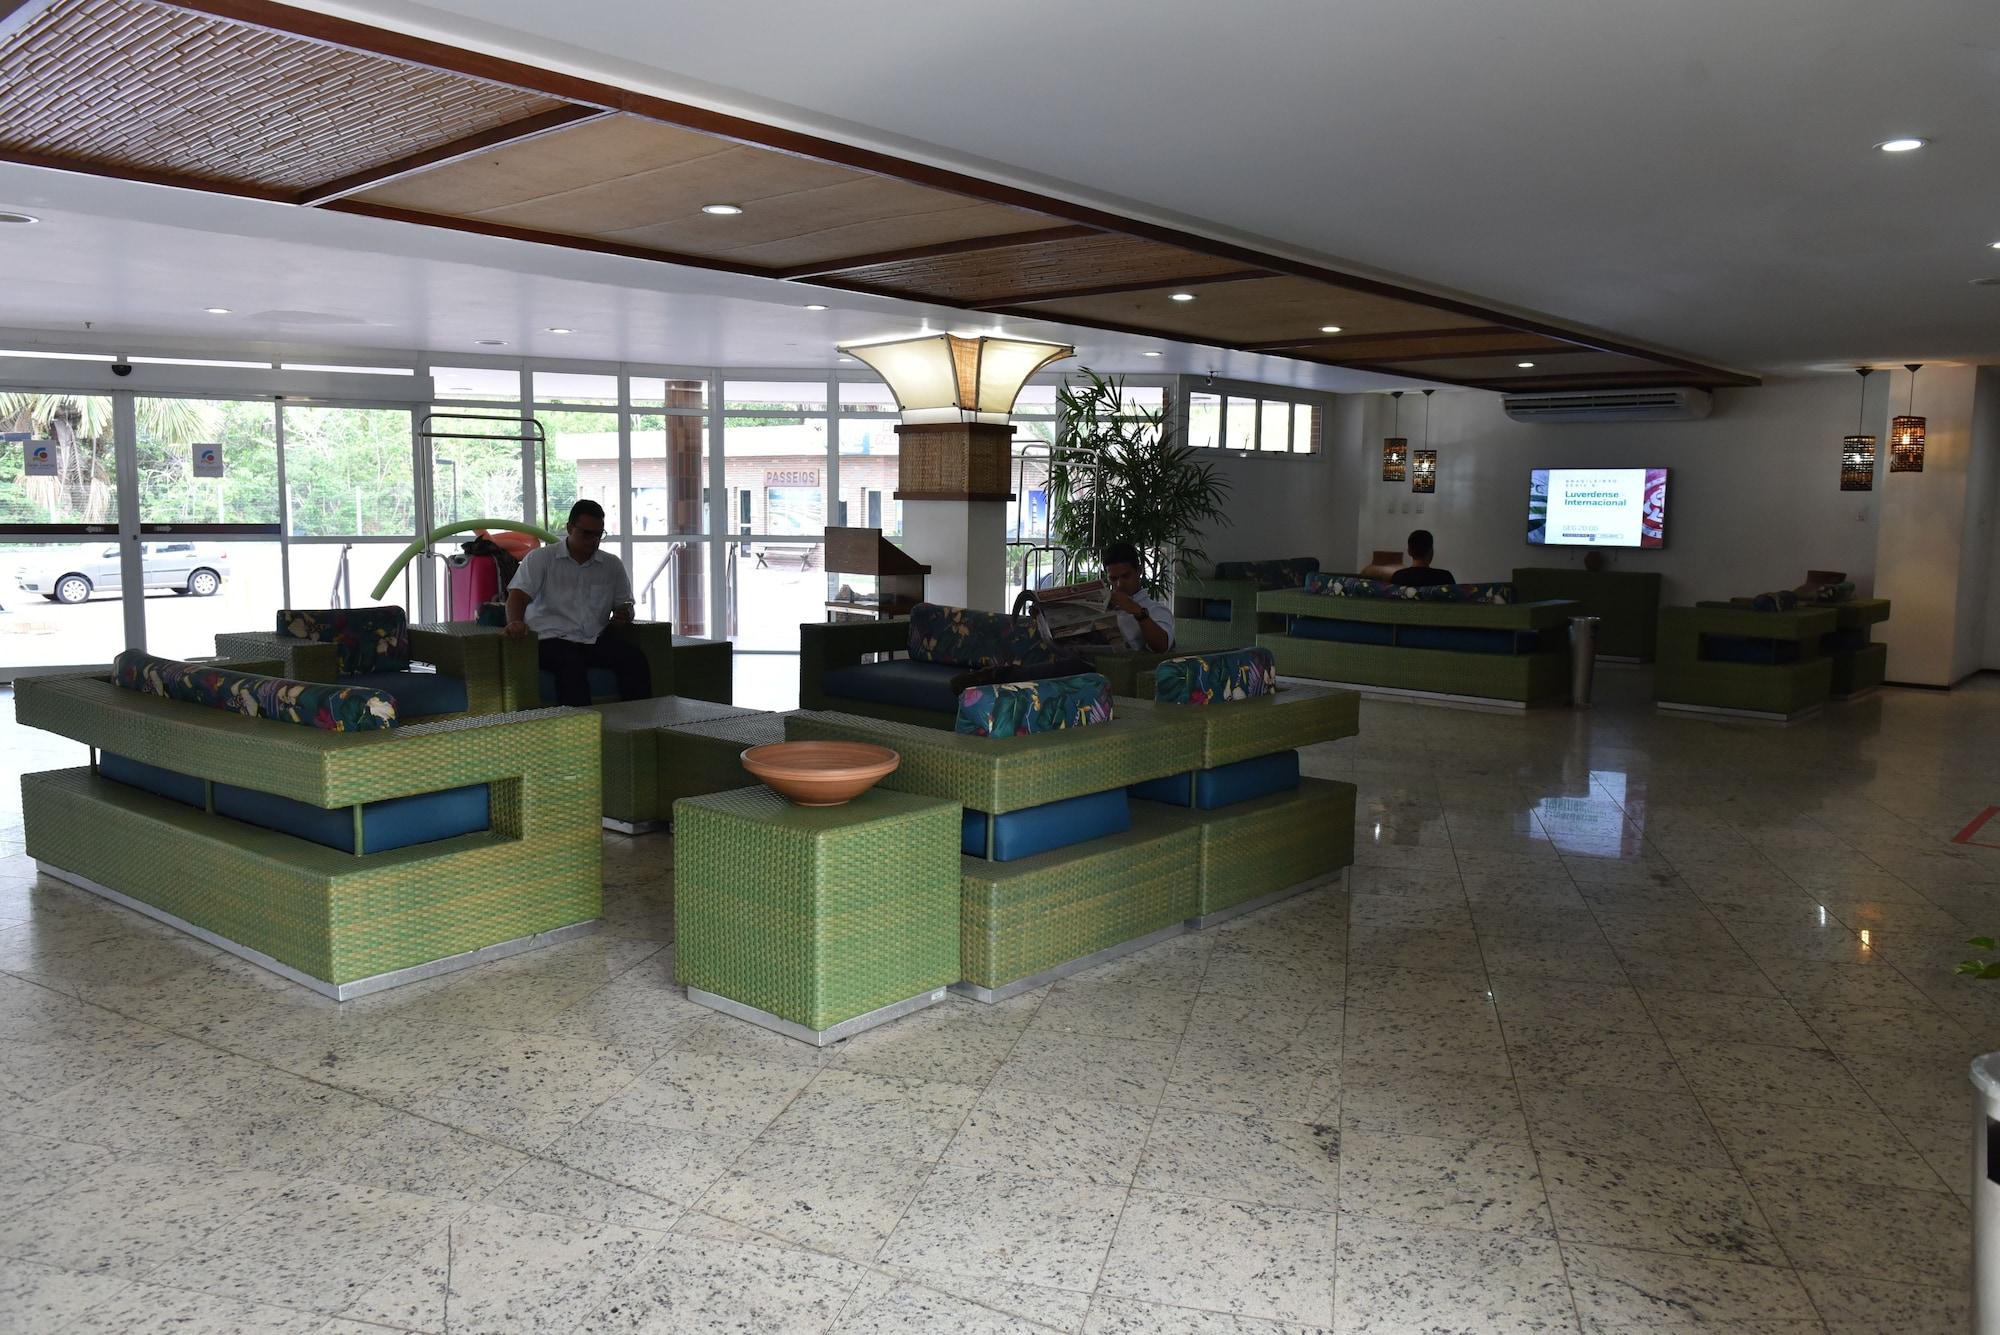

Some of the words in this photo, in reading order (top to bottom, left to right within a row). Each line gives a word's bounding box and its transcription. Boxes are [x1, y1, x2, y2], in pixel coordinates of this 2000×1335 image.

[767, 471, 816, 484] PASSEIOS
[1565, 490, 1619, 498] Luverdense
[1564, 499, 1627, 507] Internacional
